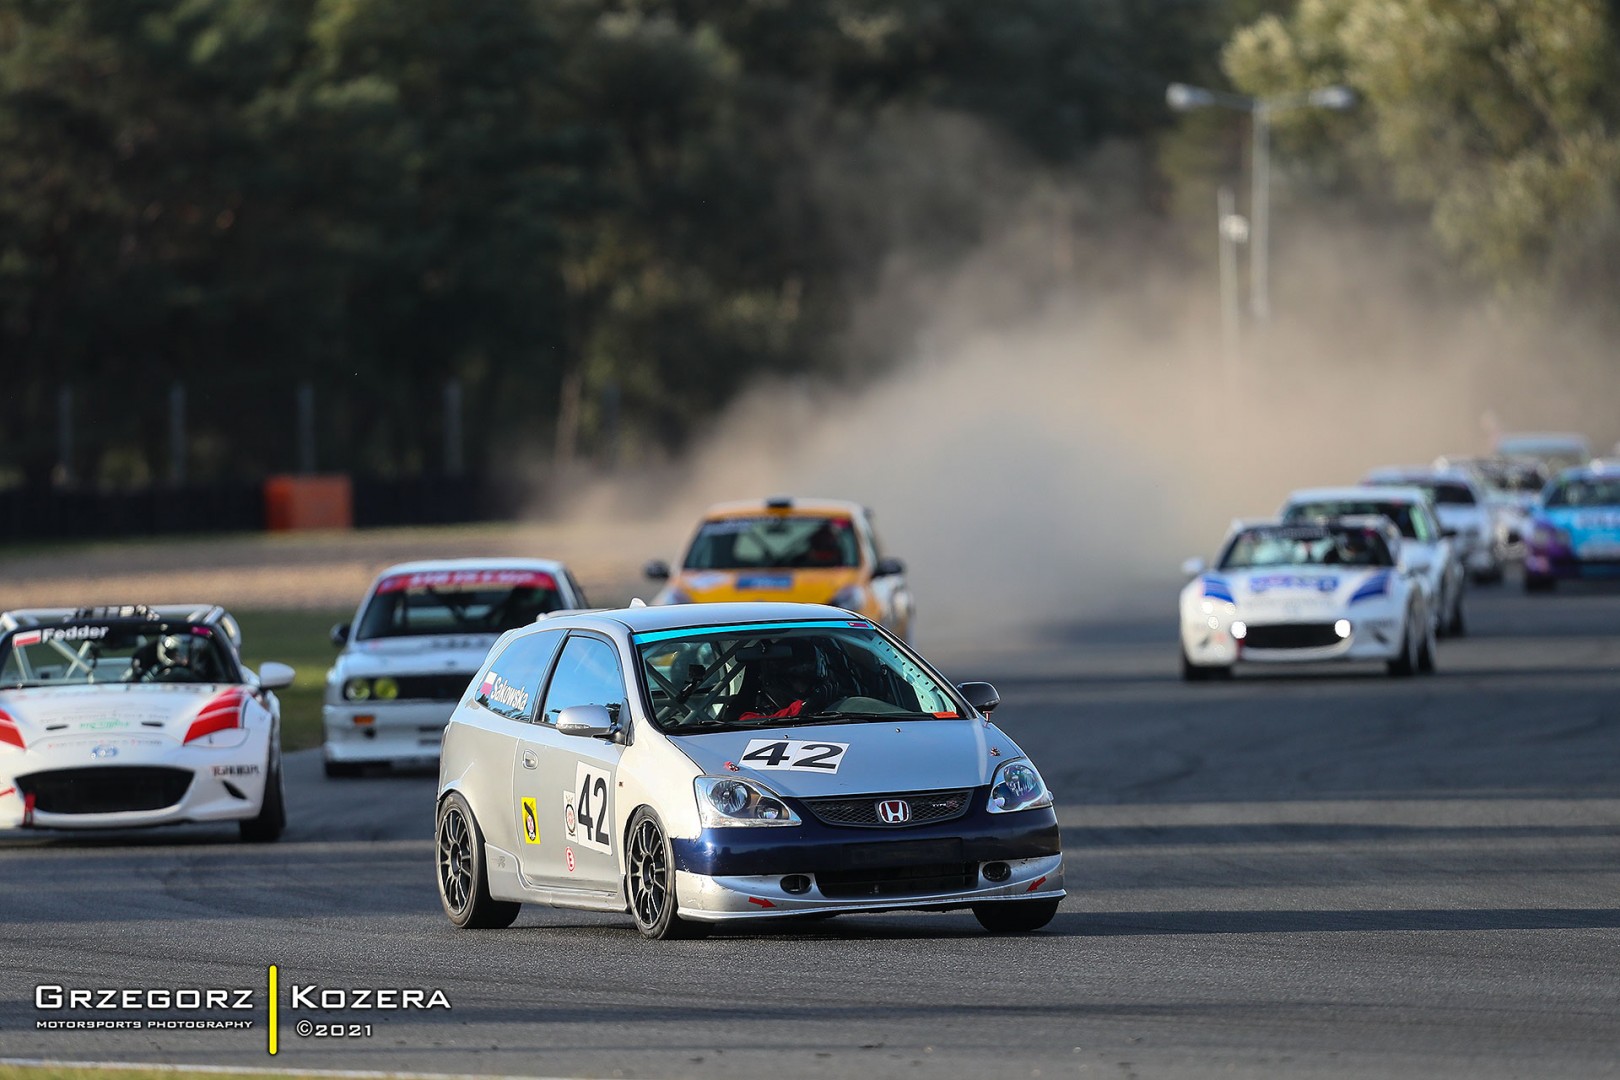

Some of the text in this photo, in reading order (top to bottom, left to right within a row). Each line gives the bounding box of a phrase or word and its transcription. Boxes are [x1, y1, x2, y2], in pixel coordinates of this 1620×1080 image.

[42, 625, 109, 643] Fedder
[490, 676, 529, 711] Sakowska
[742, 742, 844, 770] 42
[577, 773, 610, 846] 42
